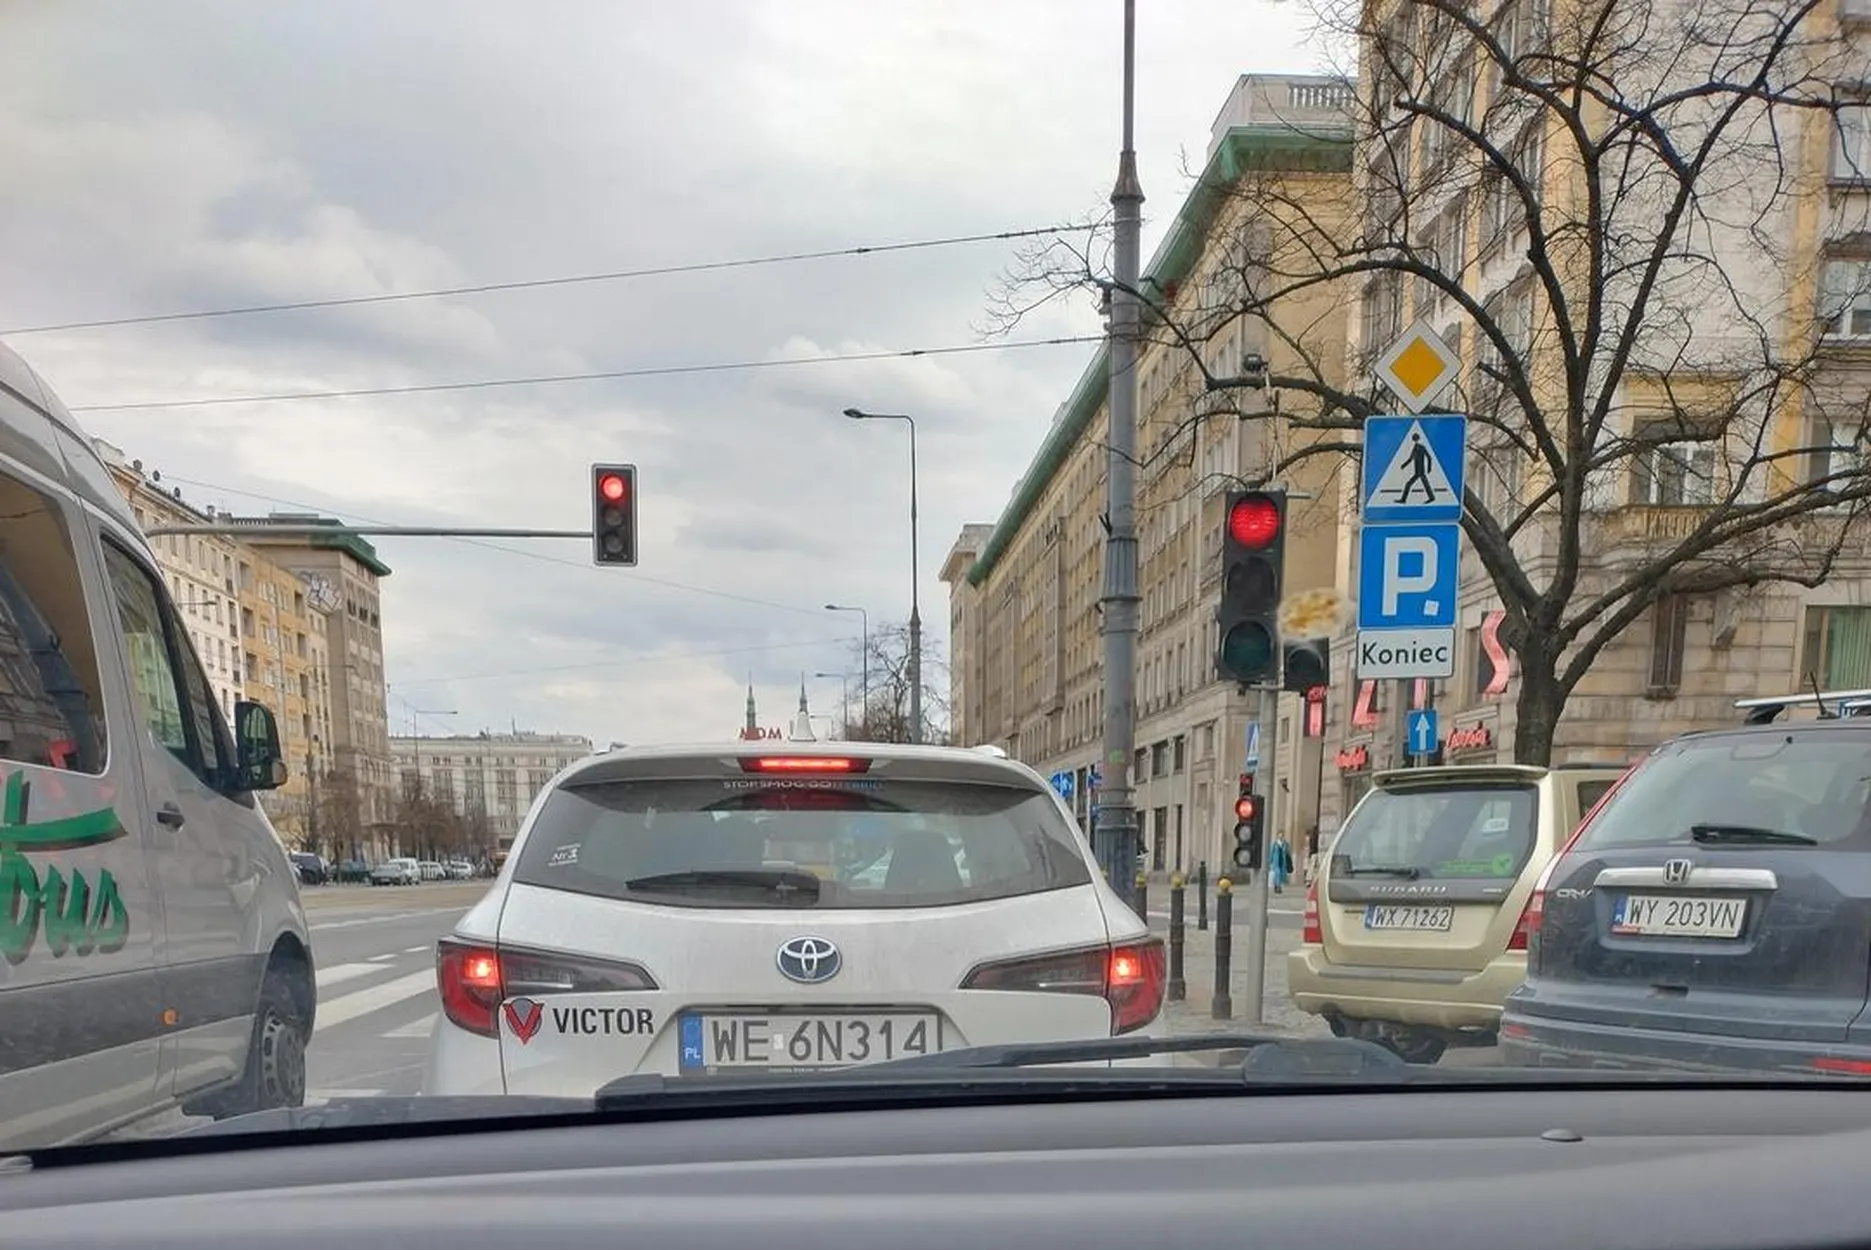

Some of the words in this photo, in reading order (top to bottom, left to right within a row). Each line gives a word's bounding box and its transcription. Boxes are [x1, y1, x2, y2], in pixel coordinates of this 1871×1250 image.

[1362, 642, 1448, 667] Koniec
[1374, 906, 1396, 926] WX
[1401, 908, 1450, 928] 71262
[1630, 898, 1659, 924] WY
[1664, 901, 1740, 929] 203VN
[553, 1007, 654, 1034] VICTOR
[684, 1045, 701, 1060] PL
[712, 1019, 770, 1063] WE
[788, 1018, 929, 1063] 6N314
